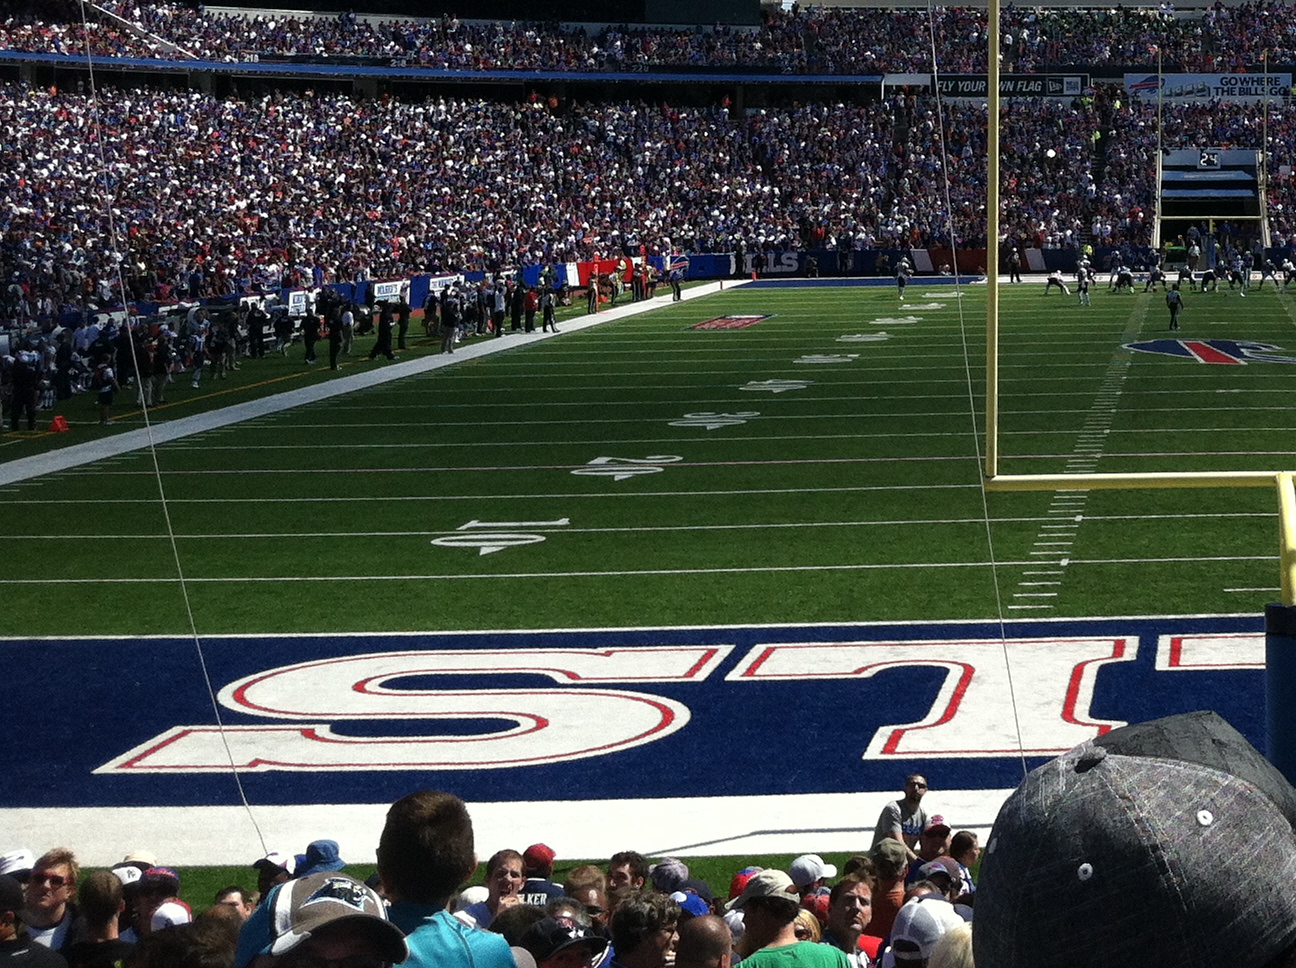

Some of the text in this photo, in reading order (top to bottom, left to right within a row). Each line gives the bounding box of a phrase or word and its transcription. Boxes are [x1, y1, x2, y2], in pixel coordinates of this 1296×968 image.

[938, 80, 955, 92] FLY
[958, 80, 986, 92] YOUR
[998, 80, 1014, 92] WN
[1017, 80, 1043, 92] FLAG
[1220, 76, 1281, 86] GO WHERE
[1213, 87, 1237, 96] THE
[1238, 87, 1268, 96] BILLS
[1200, 152, 1218, 166] 24
